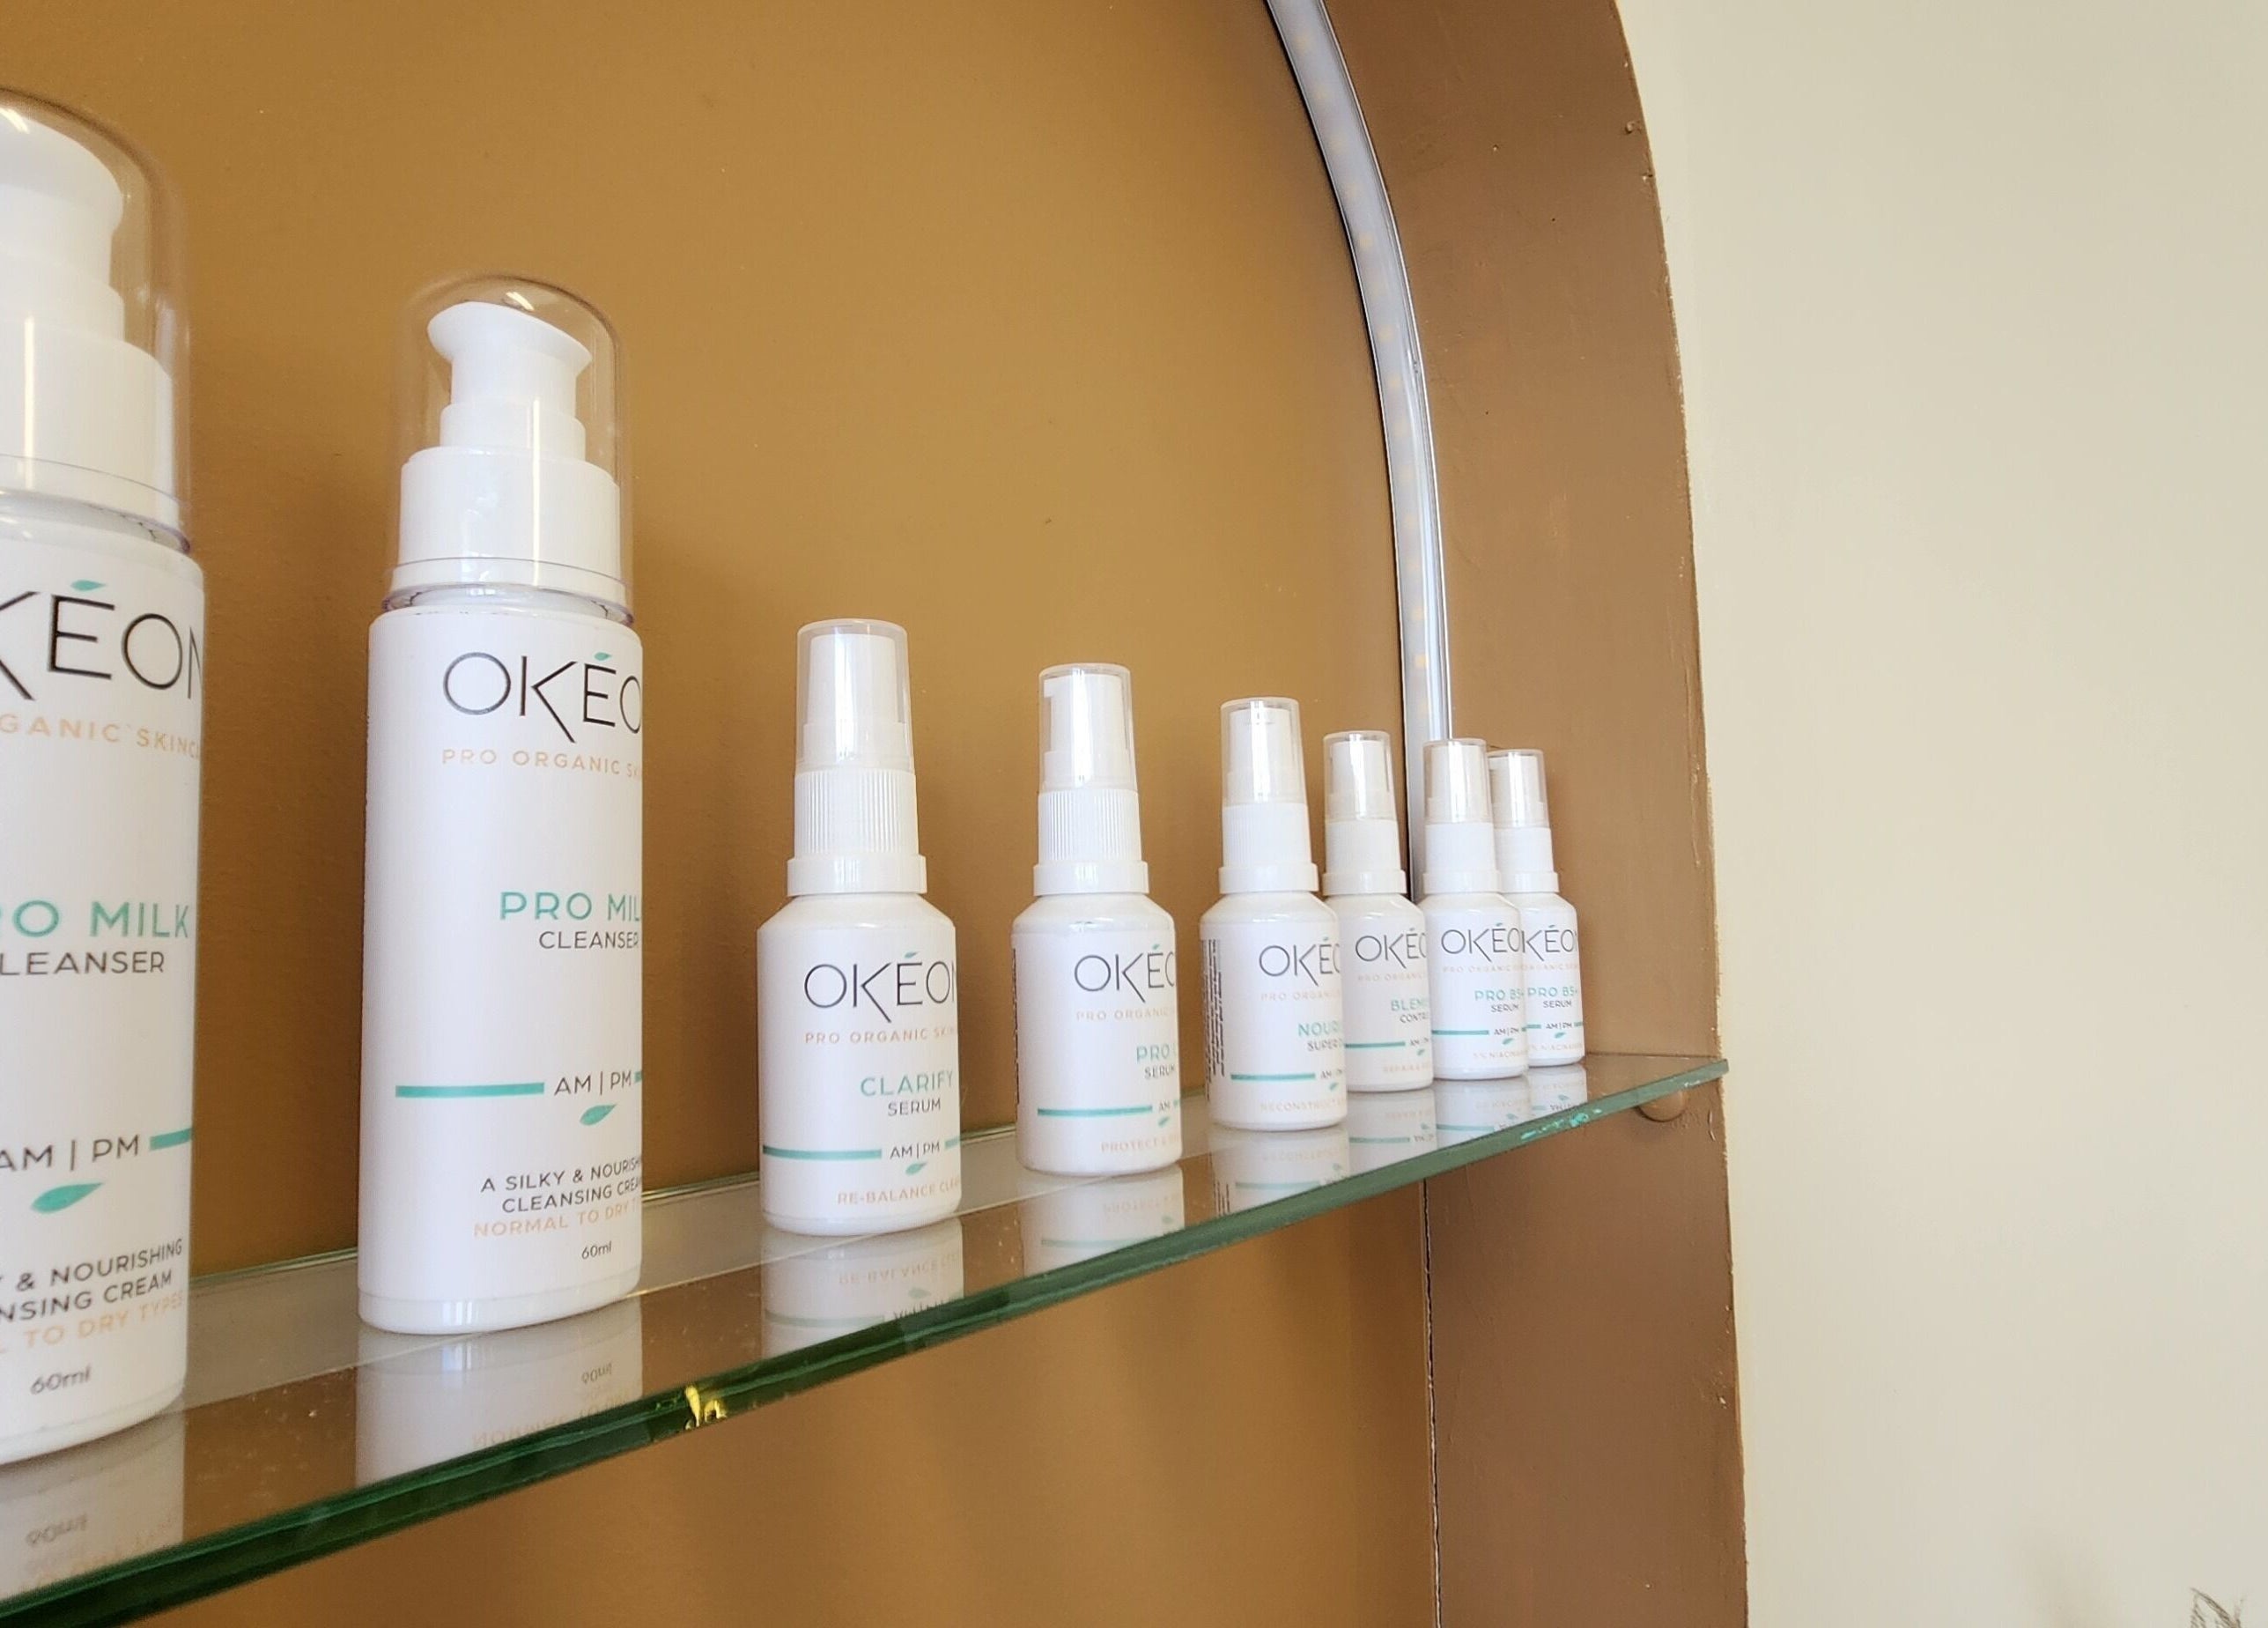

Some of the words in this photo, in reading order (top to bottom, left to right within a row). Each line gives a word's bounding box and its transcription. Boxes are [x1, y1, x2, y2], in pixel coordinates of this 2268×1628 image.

[441, 749, 497, 765] PRO
[512, 751, 620, 775] ORGANIC
[89, 900, 189, 938] MILK
[499, 892, 593, 921] PRO
[1474, 989, 1505, 1001] PRO
[1527, 987, 1557, 997] PRO
[805, 1032, 839, 1044] PRO
[850, 1028, 927, 1043] ORGANIC
[1137, 1043, 1170, 1062] PRO
[554, 1076, 592, 1096] AM
[610, 1070, 632, 1090] PM
[860, 1069, 954, 1098] CLARIFY
[888, 1099, 942, 1117] SERUM
[92, 1135, 139, 1162] PM
[890, 1147, 912, 1160] AM
[923, 1142, 941, 1155] PM
[480, 1178, 495, 1193] A
[505, 1170, 565, 1191] SILKY
[573, 1169, 584, 1183] &
[838, 1182, 936, 1205] RE-BALANCE
[501, 1185, 612, 1213] CLEANSING
[474, 1216, 569, 1238] NORMAL
[578, 1210, 600, 1225] TO
[581, 1241, 613, 1261] 60ml
[16, 1272, 35, 1291] &
[50, 1238, 183, 1286] NOURISHING
[103, 1269, 172, 1304] CREAM
[26, 1325, 65, 1347] TO
[78, 1311, 129, 1339] DRY
[31, 1364, 92, 1395] 60ml
